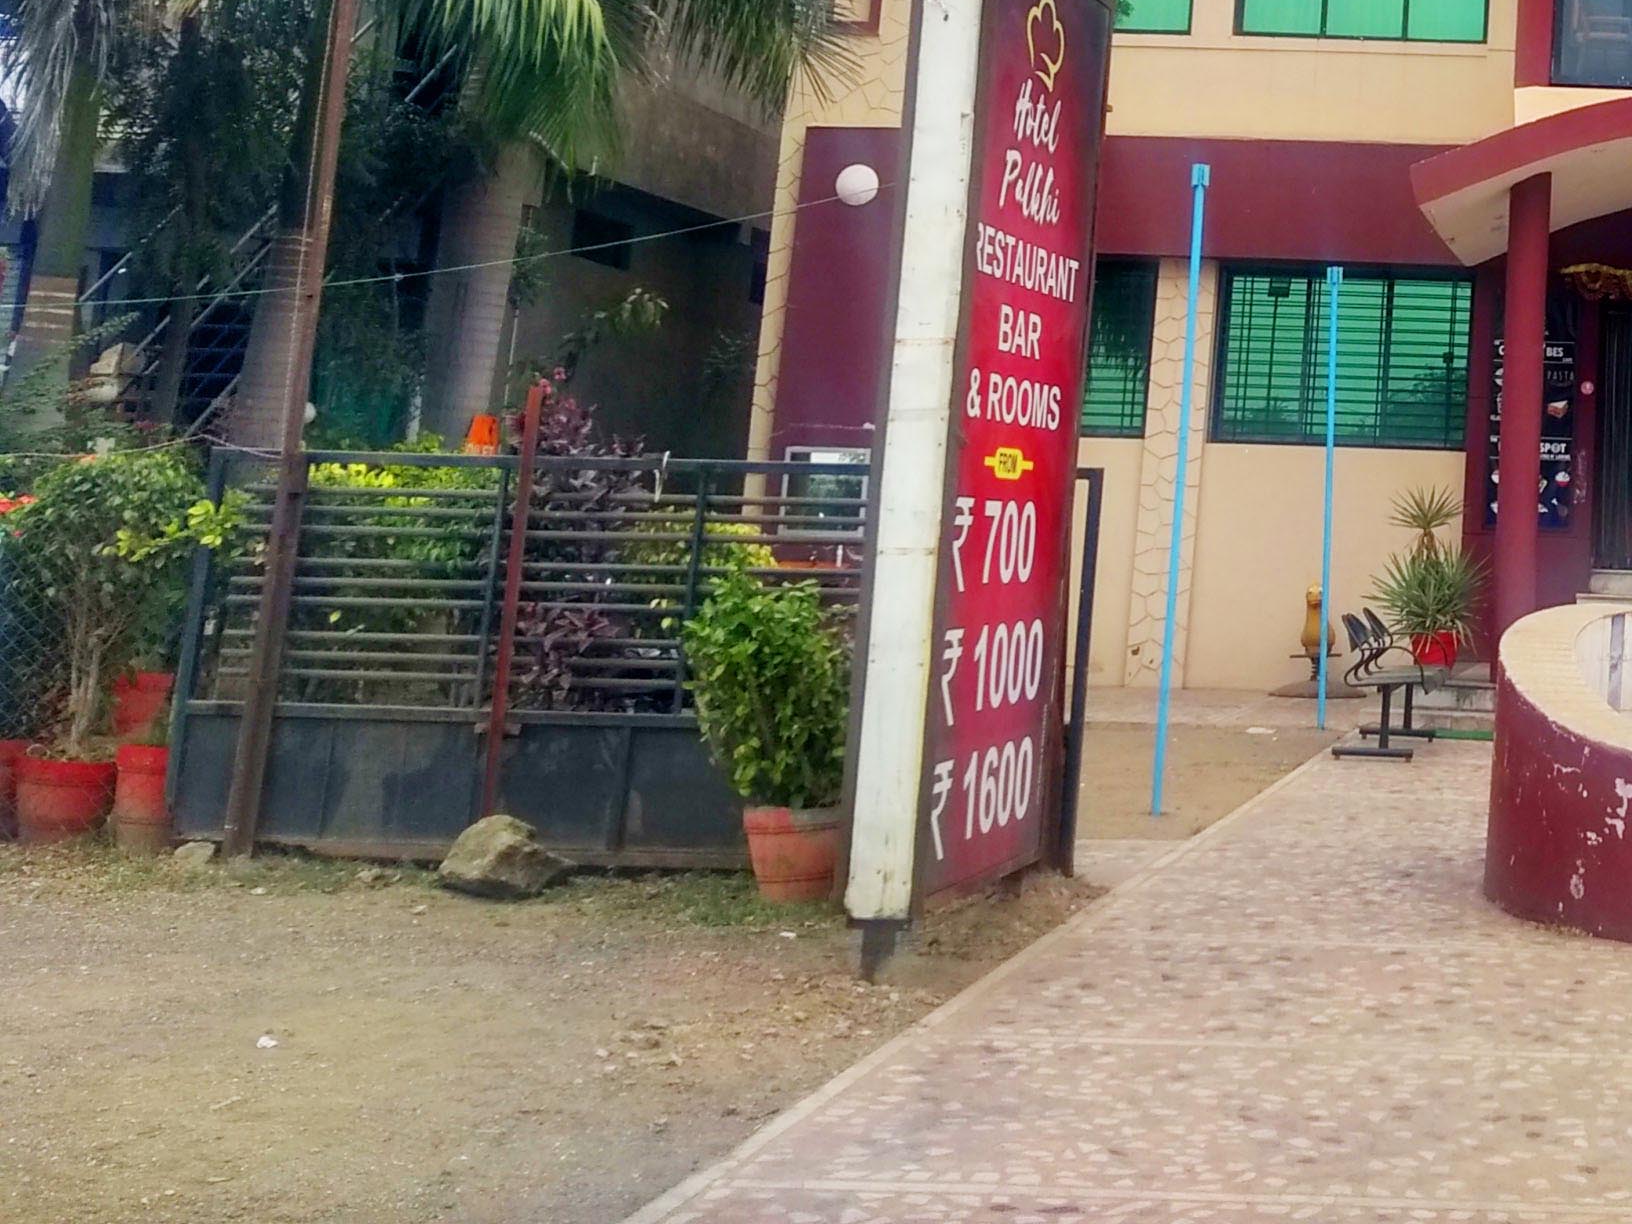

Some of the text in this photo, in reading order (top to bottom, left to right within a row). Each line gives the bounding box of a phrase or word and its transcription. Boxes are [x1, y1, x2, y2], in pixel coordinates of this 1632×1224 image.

[1013, 78, 1062, 154] Hotel
[999, 148, 1060, 225] Palkhi
[976, 222, 1080, 303] RESTAURANT
[997, 303, 1042, 360] BAR
[966, 368, 1062, 431] & ROOMS
[999, 452, 1019, 475] FROM
[982, 500, 1037, 585] 700
[973, 617, 1044, 712] 1000
[962, 735, 1034, 841] 1600
